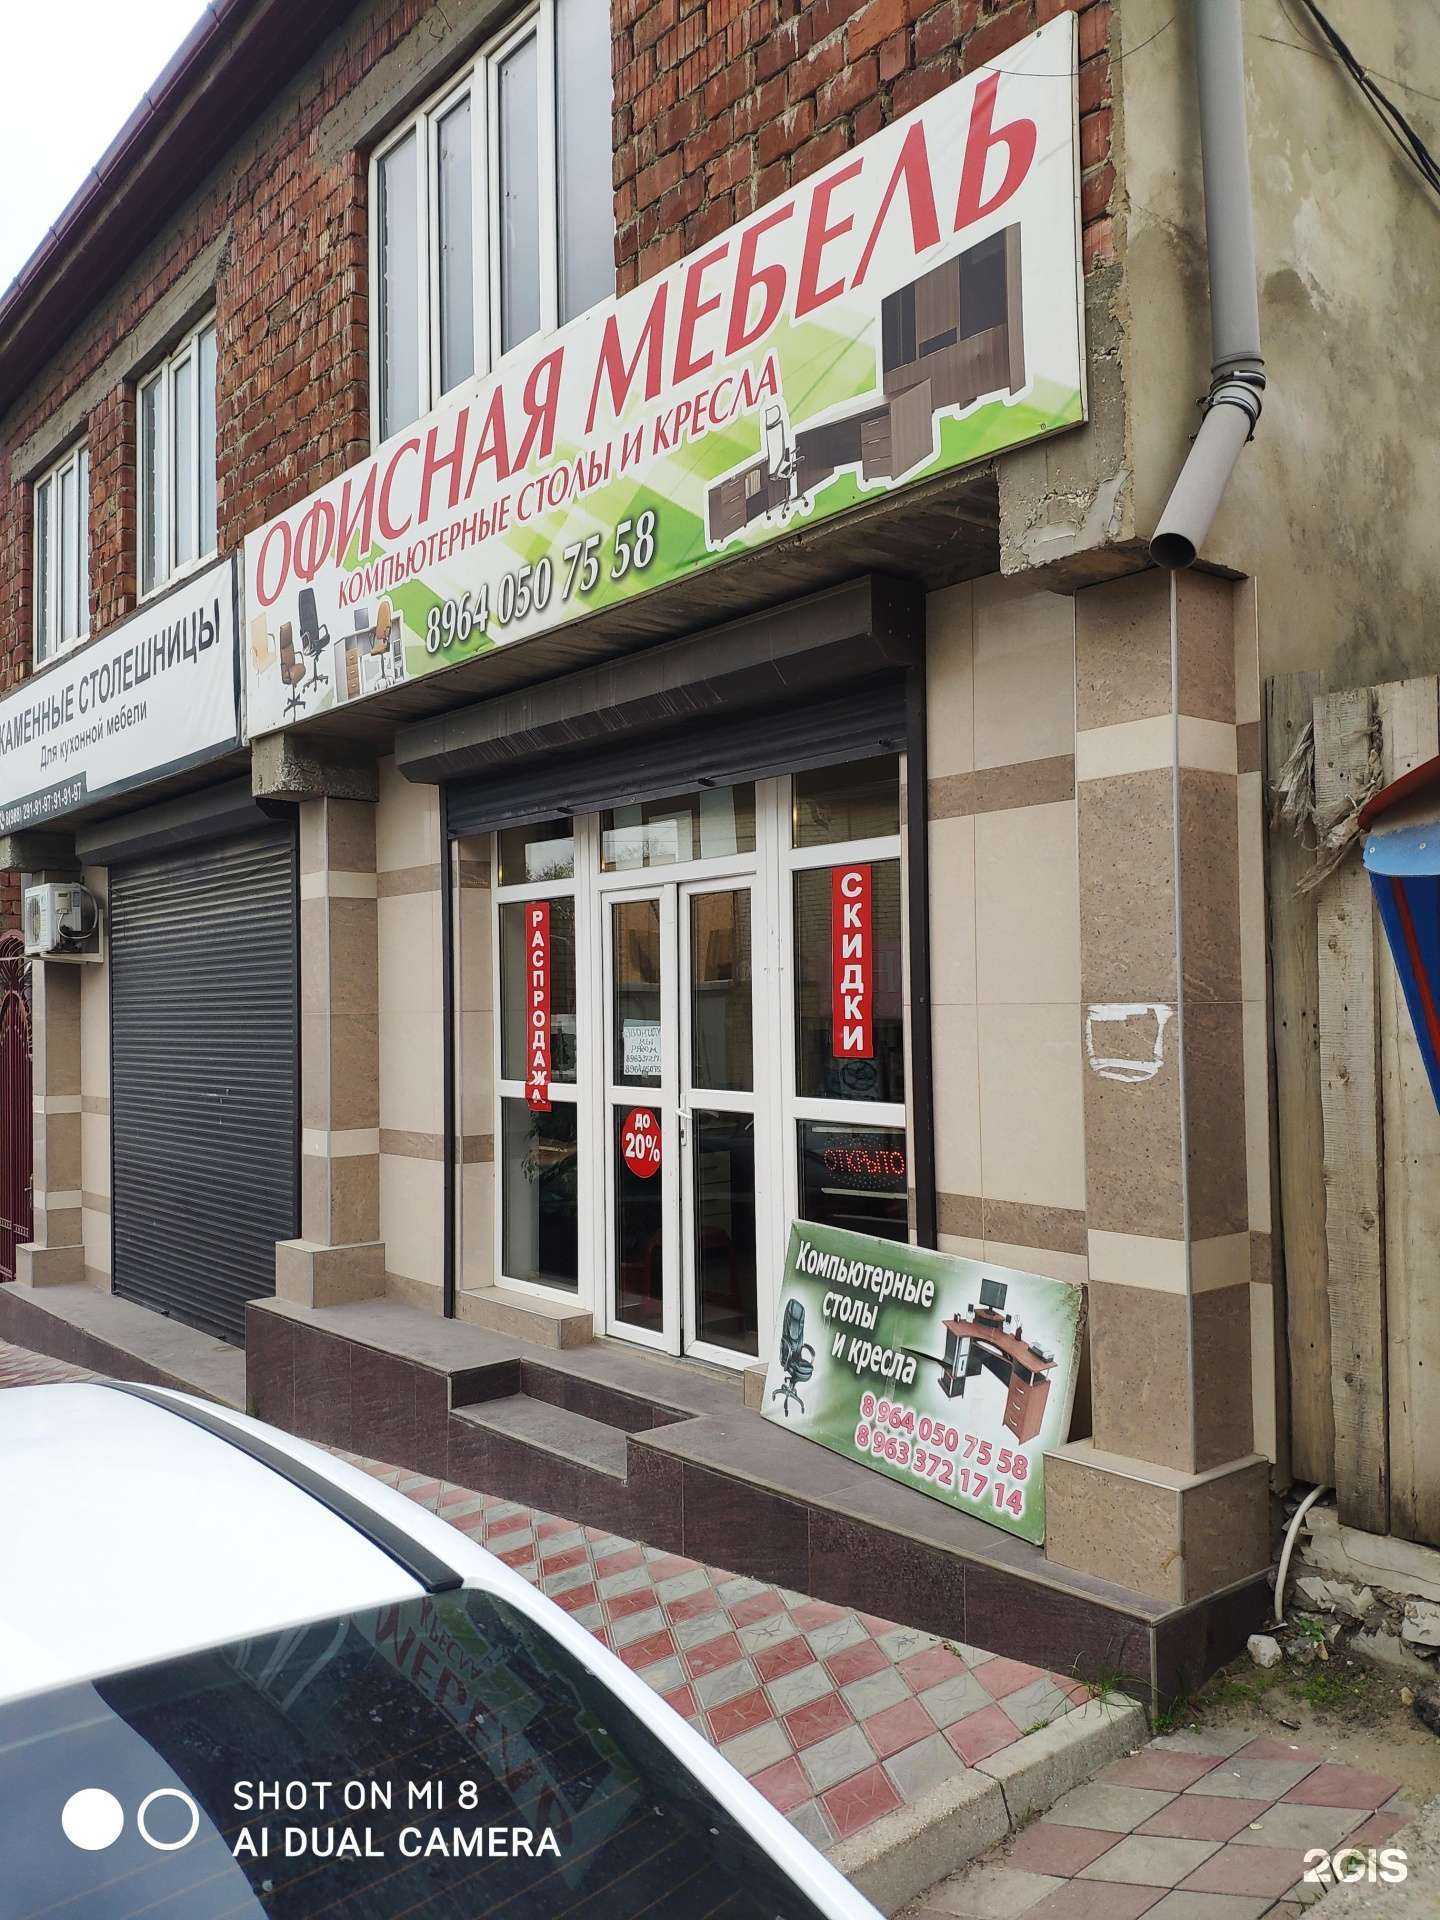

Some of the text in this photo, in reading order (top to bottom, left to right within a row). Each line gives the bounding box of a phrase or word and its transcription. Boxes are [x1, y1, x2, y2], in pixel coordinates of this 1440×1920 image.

[256, 70, 1037, 607] ОФИСНАЯ МЕБЕЛЬ
[338, 355, 777, 609] КОМПЬЮТЕРНЫЕ СТОЛЫ И КРЕСЛА
[425, 508, 657, 655] 8964 050 75 58
[0, 598, 220, 755] КАМЕННЫЕ СТОЛЕШНИЦЫ
[40, 701, 147, 771] Для кухонной мебели
[840, 872, 864, 1051] СКИДКИ
[529, 910, 547, 1104] РАСПРОДАЖА
[625, 1132, 660, 1162] 20%
[824, 1149, 905, 1174] ОТКРЫТО
[796, 1240, 934, 1308] Компьютерные
[822, 1291, 879, 1330] столы
[831, 1332, 917, 1384] и кресла
[857, 1424, 1023, 1515] 8 963 372 17 14
[862, 1395, 1028, 1480] 8 964 050 75 58
